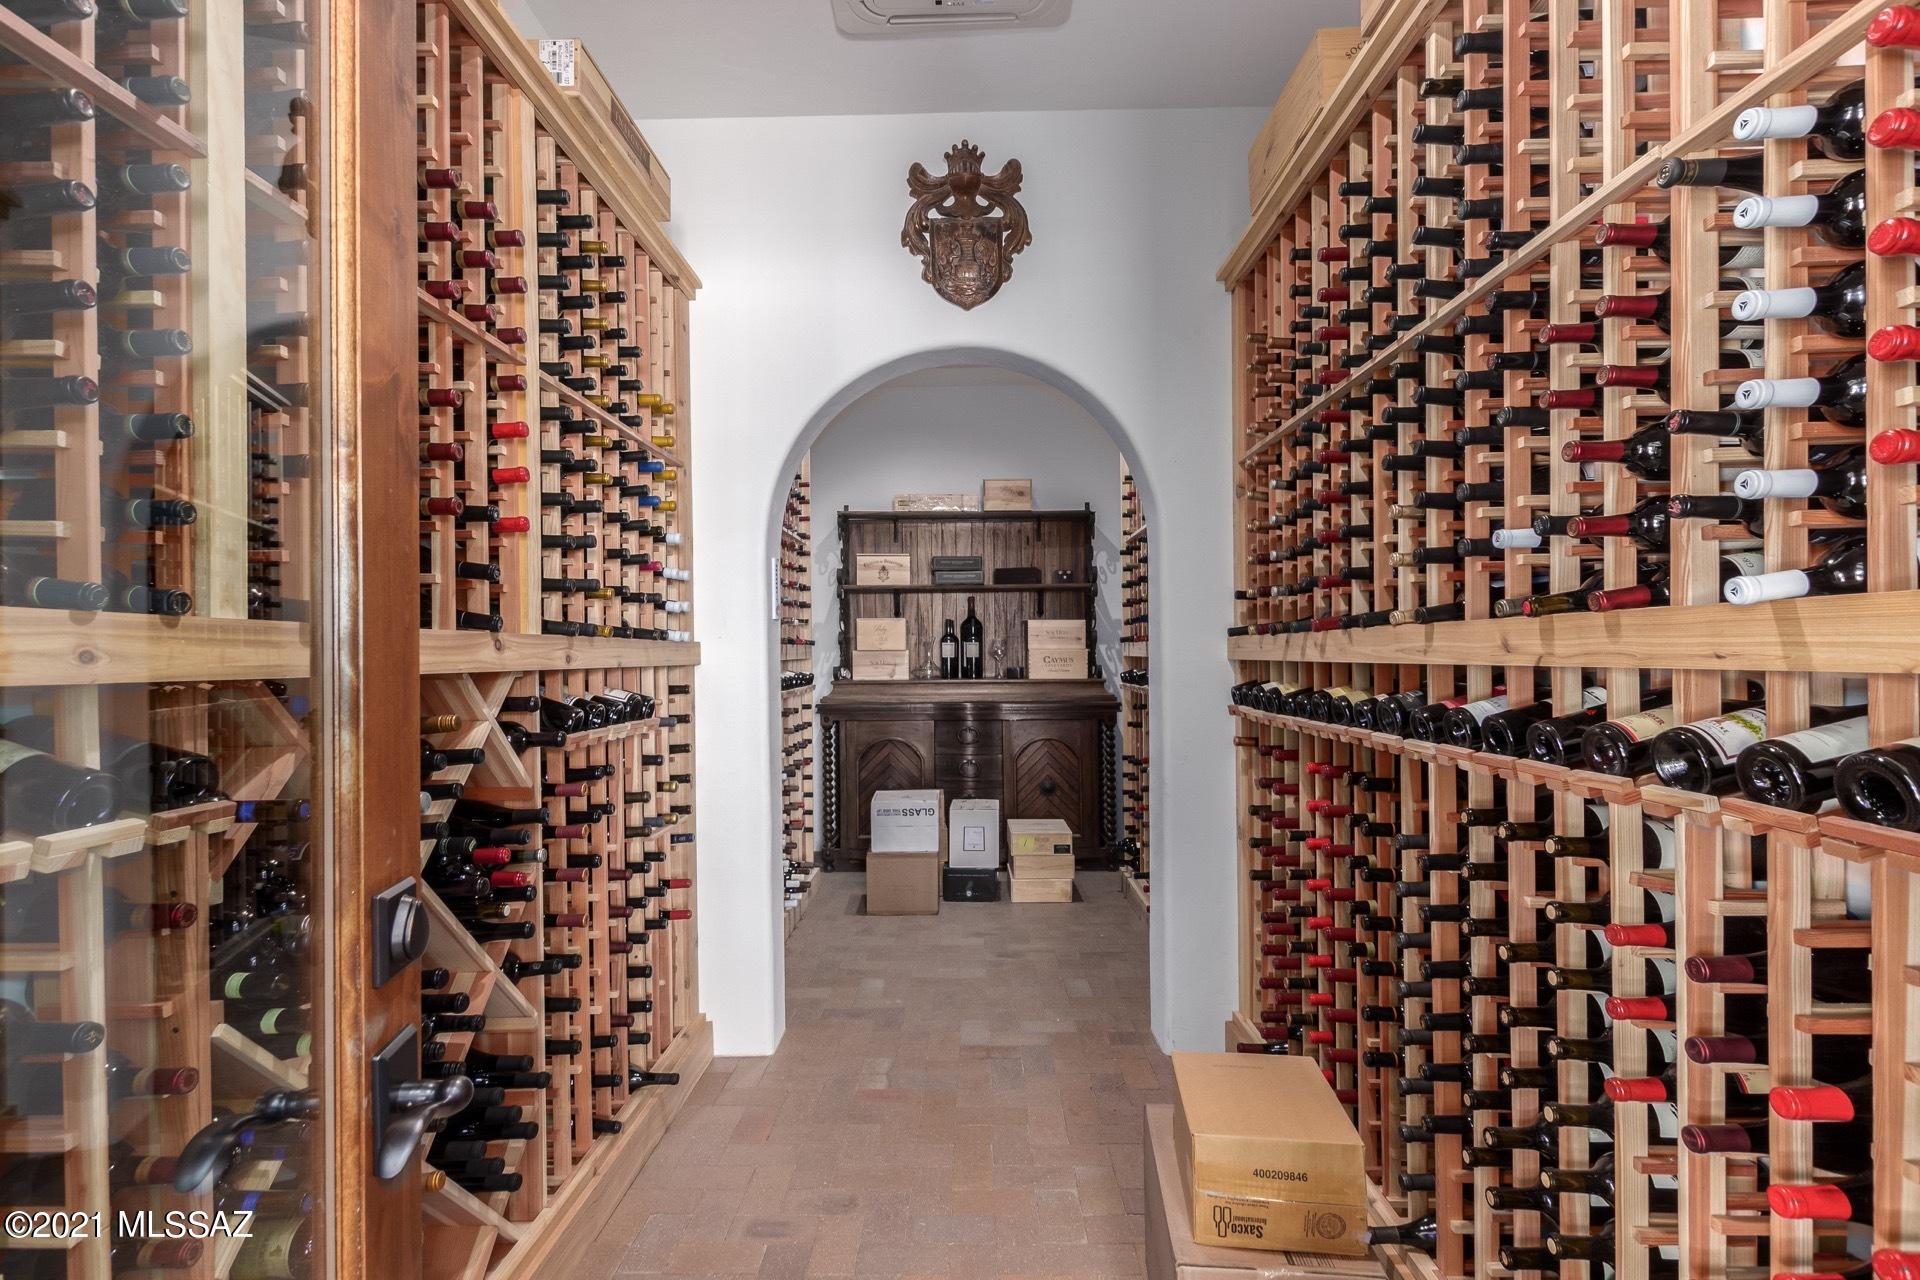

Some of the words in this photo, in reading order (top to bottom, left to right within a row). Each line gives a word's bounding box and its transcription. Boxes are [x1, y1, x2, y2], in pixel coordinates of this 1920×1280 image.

[901, 808, 935, 817] GLASS
[1253, 1168, 1308, 1182] 400209846
[1231, 1223, 1263, 1239] Saxco
